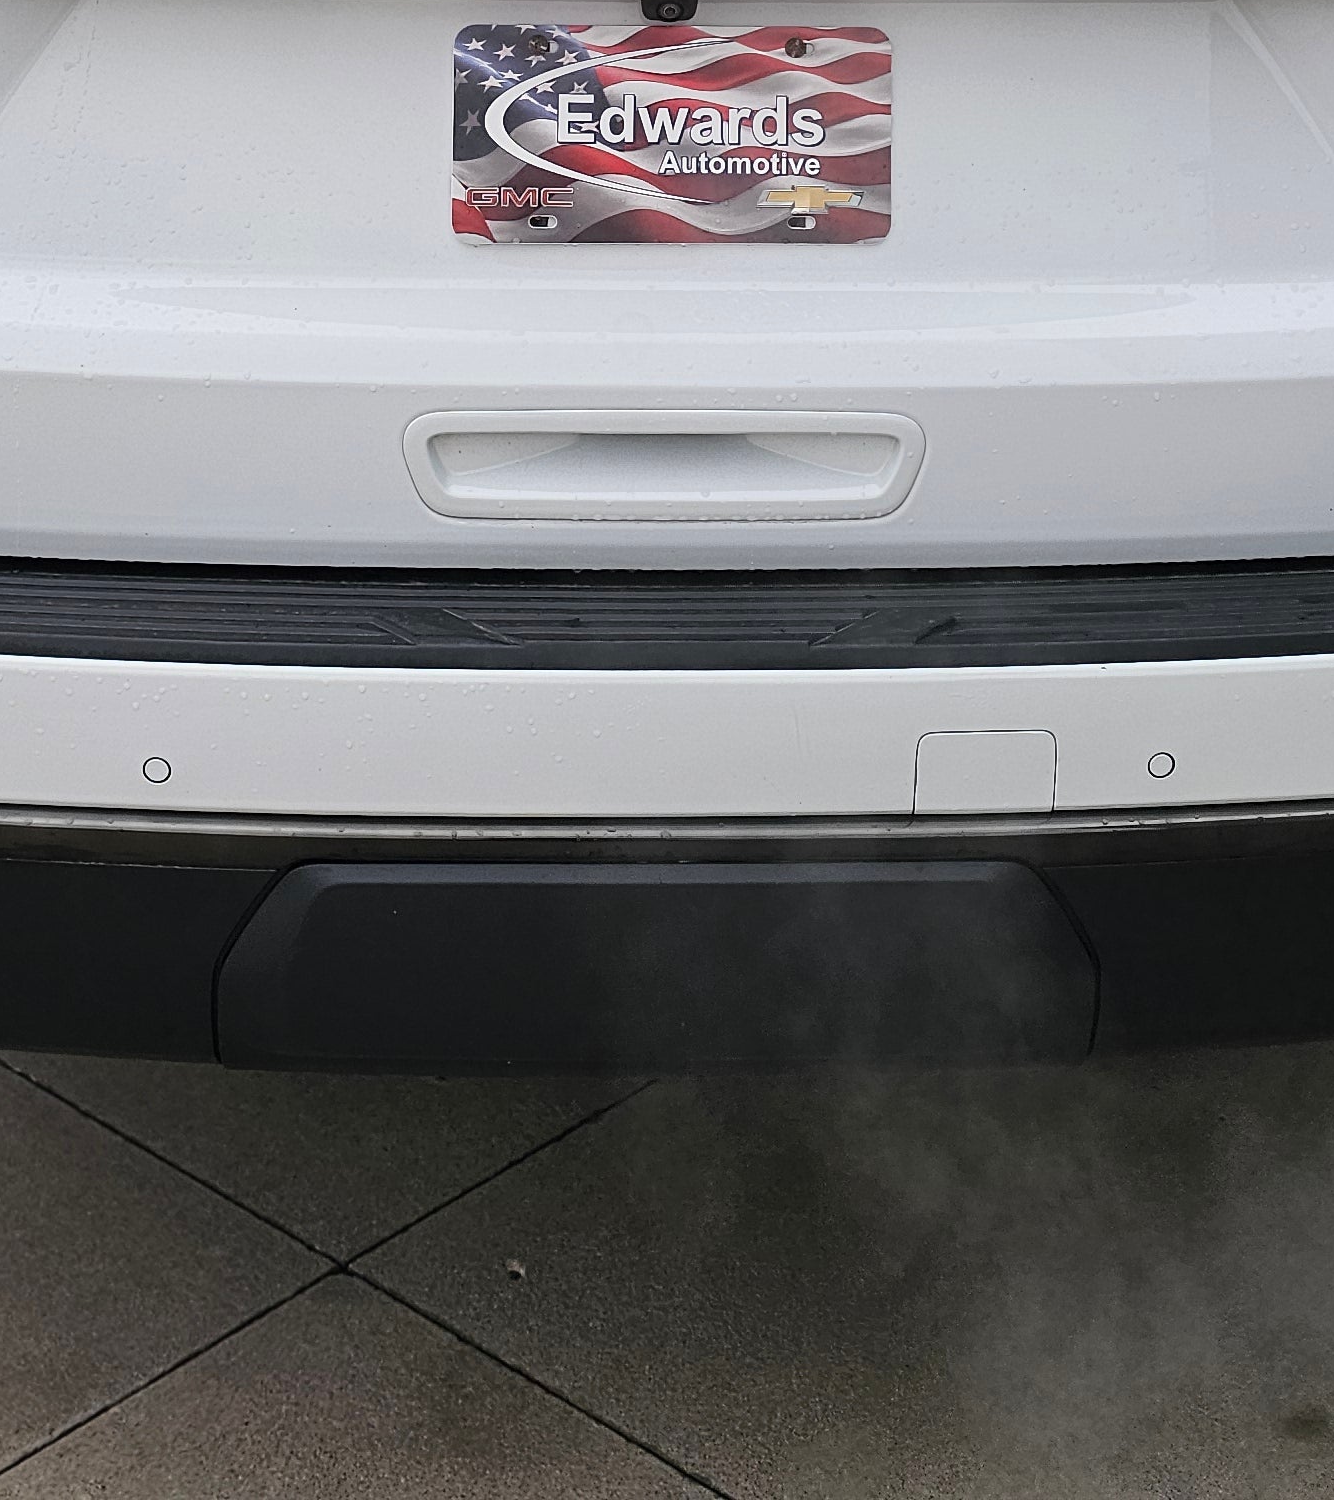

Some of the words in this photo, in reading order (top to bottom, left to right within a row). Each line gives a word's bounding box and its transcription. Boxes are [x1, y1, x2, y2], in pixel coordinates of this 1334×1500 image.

[557, 94, 825, 146] Edwards
[659, 151, 821, 176] Automotive
[466, 187, 574, 207] GMC
